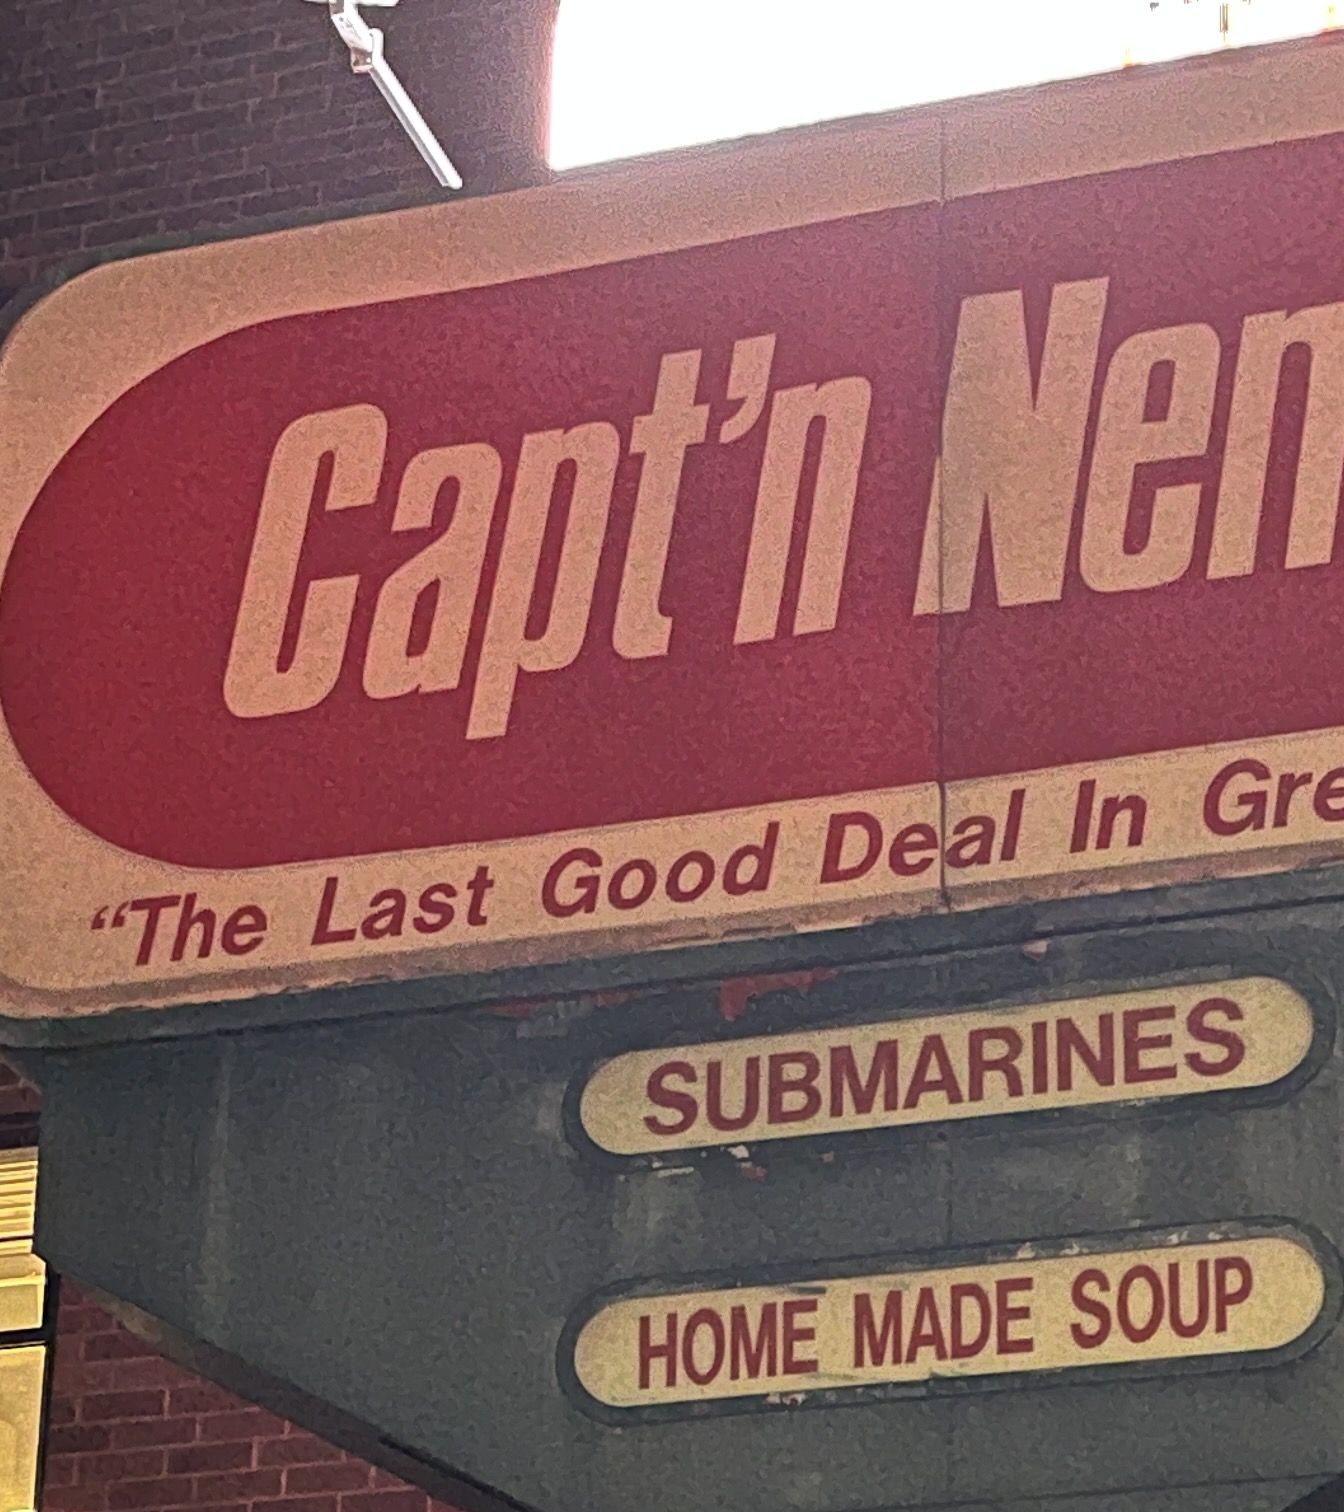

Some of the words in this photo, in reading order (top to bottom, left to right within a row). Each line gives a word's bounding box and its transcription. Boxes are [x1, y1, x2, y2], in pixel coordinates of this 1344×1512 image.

[222, 336, 870, 739] Capt’n
[311, 866, 494, 945] Last
[540, 823, 778, 917] Good
[819, 789, 1026, 875] Deal
[1070, 779, 1145, 853] In
[642, 997, 1246, 1136] SUBMARINES
[638, 1300, 818, 1390] HOME
[854, 1276, 1034, 1369] MADE
[1070, 1256, 1253, 1349] SOUP
